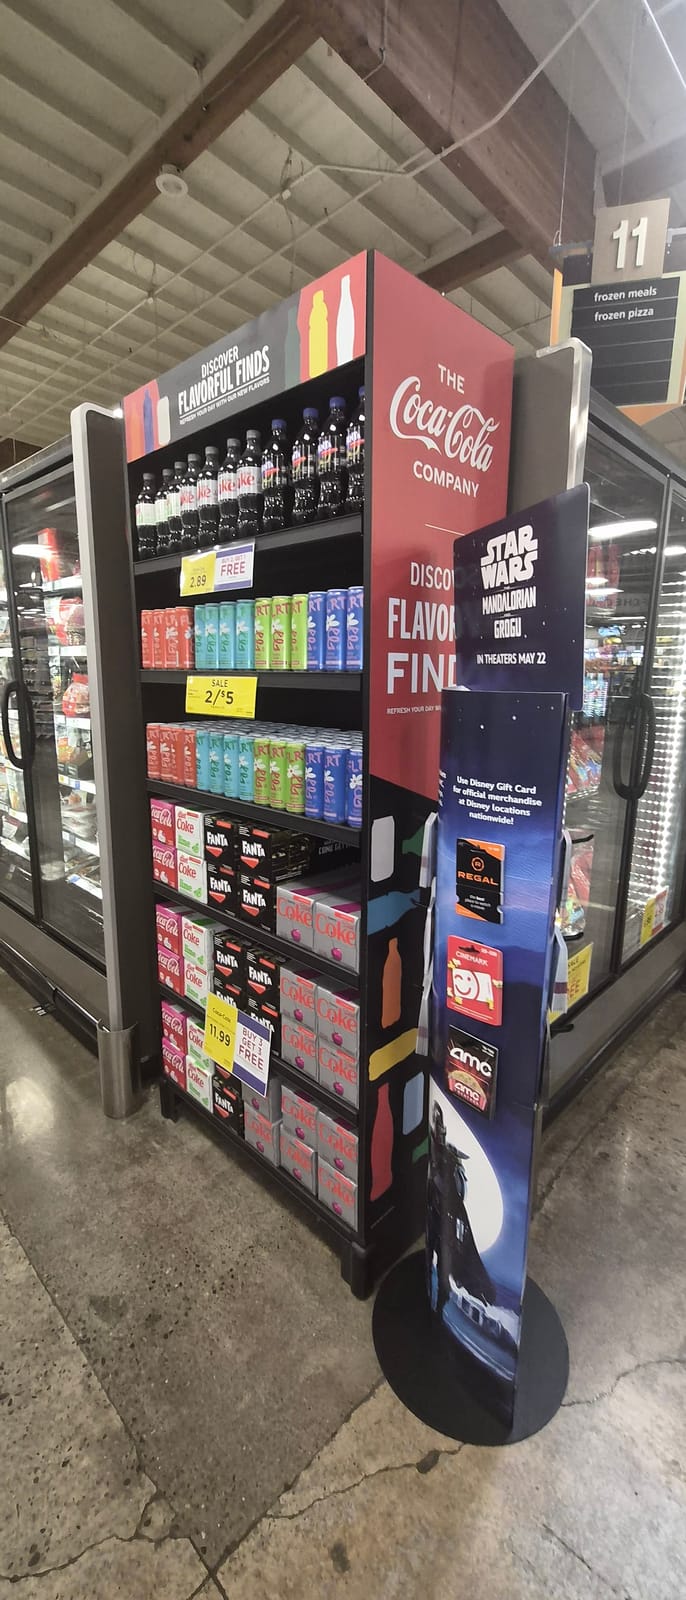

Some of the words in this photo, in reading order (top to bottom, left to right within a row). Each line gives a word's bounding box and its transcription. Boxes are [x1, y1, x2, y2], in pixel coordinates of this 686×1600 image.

[613, 217, 648, 269] 11
[594, 291, 626, 302] frozen
[628, 286, 657, 298] meals
[594, 310, 626, 322] frozen
[628, 307, 654, 320] pizza
[201, 345, 239, 379] DISCOVER
[178, 370, 233, 415] FLAVORFUL
[235, 345, 270, 387] FINDS
[227, 393, 237, 402] OUR
[236, 387, 248, 397] NEW
[248, 376, 270, 392] FLAVORS
[437, 363, 465, 395] THE
[389, 375, 500, 472] Coca-Cola
[413, 460, 480, 498] COMPANY
[480, 524, 538, 567] STAR
[220, 561, 246, 577] FREE
[410, 562, 455, 591] DISCO
[481, 550, 538, 590] WARS
[189, 574, 207, 588] 2.89
[482, 586, 537, 615] MANDALORIAN
[494, 617, 522, 639] GROGU
[476, 654, 484, 665] IN
[484, 652, 517, 665] THEATERS
[518, 652, 536, 665] MAY
[536, 651, 547, 665] 22
[211, 679, 228, 688] SALE
[204, 689, 234, 705] 2/$5
[452, 784, 462, 794] for
[462, 788, 486, 799] official
[487, 793, 543, 807] merchandise
[456, 775, 469, 785] Use
[469, 778, 495, 791] Disney
[496, 782, 513, 792] Gift
[514, 784, 537, 795] Card
[458, 798, 465, 806] at
[466, 798, 491, 812] Disney
[491, 803, 531, 817] locations
[469, 811, 514, 825] nationwide!
[176, 818, 195, 834] Coke
[206, 831, 229, 847] FANTA
[242, 840, 266, 857] FANTA
[178, 862, 197, 879] Coke
[457, 871, 499, 886] REGAL
[209, 876, 232, 893] FANTA
[242, 889, 267, 907] FANTA
[277, 896, 313, 928] Coke
[183, 928, 200, 946] Coke
[315, 912, 356, 946] Coke
[216, 950, 239, 968] FANTA
[455, 950, 489, 967] CINEMARK
[185, 969, 203, 988] Coke
[248, 965, 273, 986] FANTA
[280, 976, 315, 1010] Coke
[316, 997, 357, 1033] Coke
[209, 1023, 231, 1047] 11.99
[242, 1027, 257, 1040] BUY
[259, 1038, 263, 1046] 3
[242, 1037, 256, 1051] GET
[281, 1024, 317, 1057] Coke
[239, 1044, 264, 1071] FREE
[319, 1047, 357, 1084] Coke
[187, 1068, 204, 1088] Coke
[215, 1091, 234, 1113] FANTA
[281, 1095, 317, 1133] Coke
[318, 1122, 358, 1163] Coke
[318, 1167, 355, 1207] Coke
